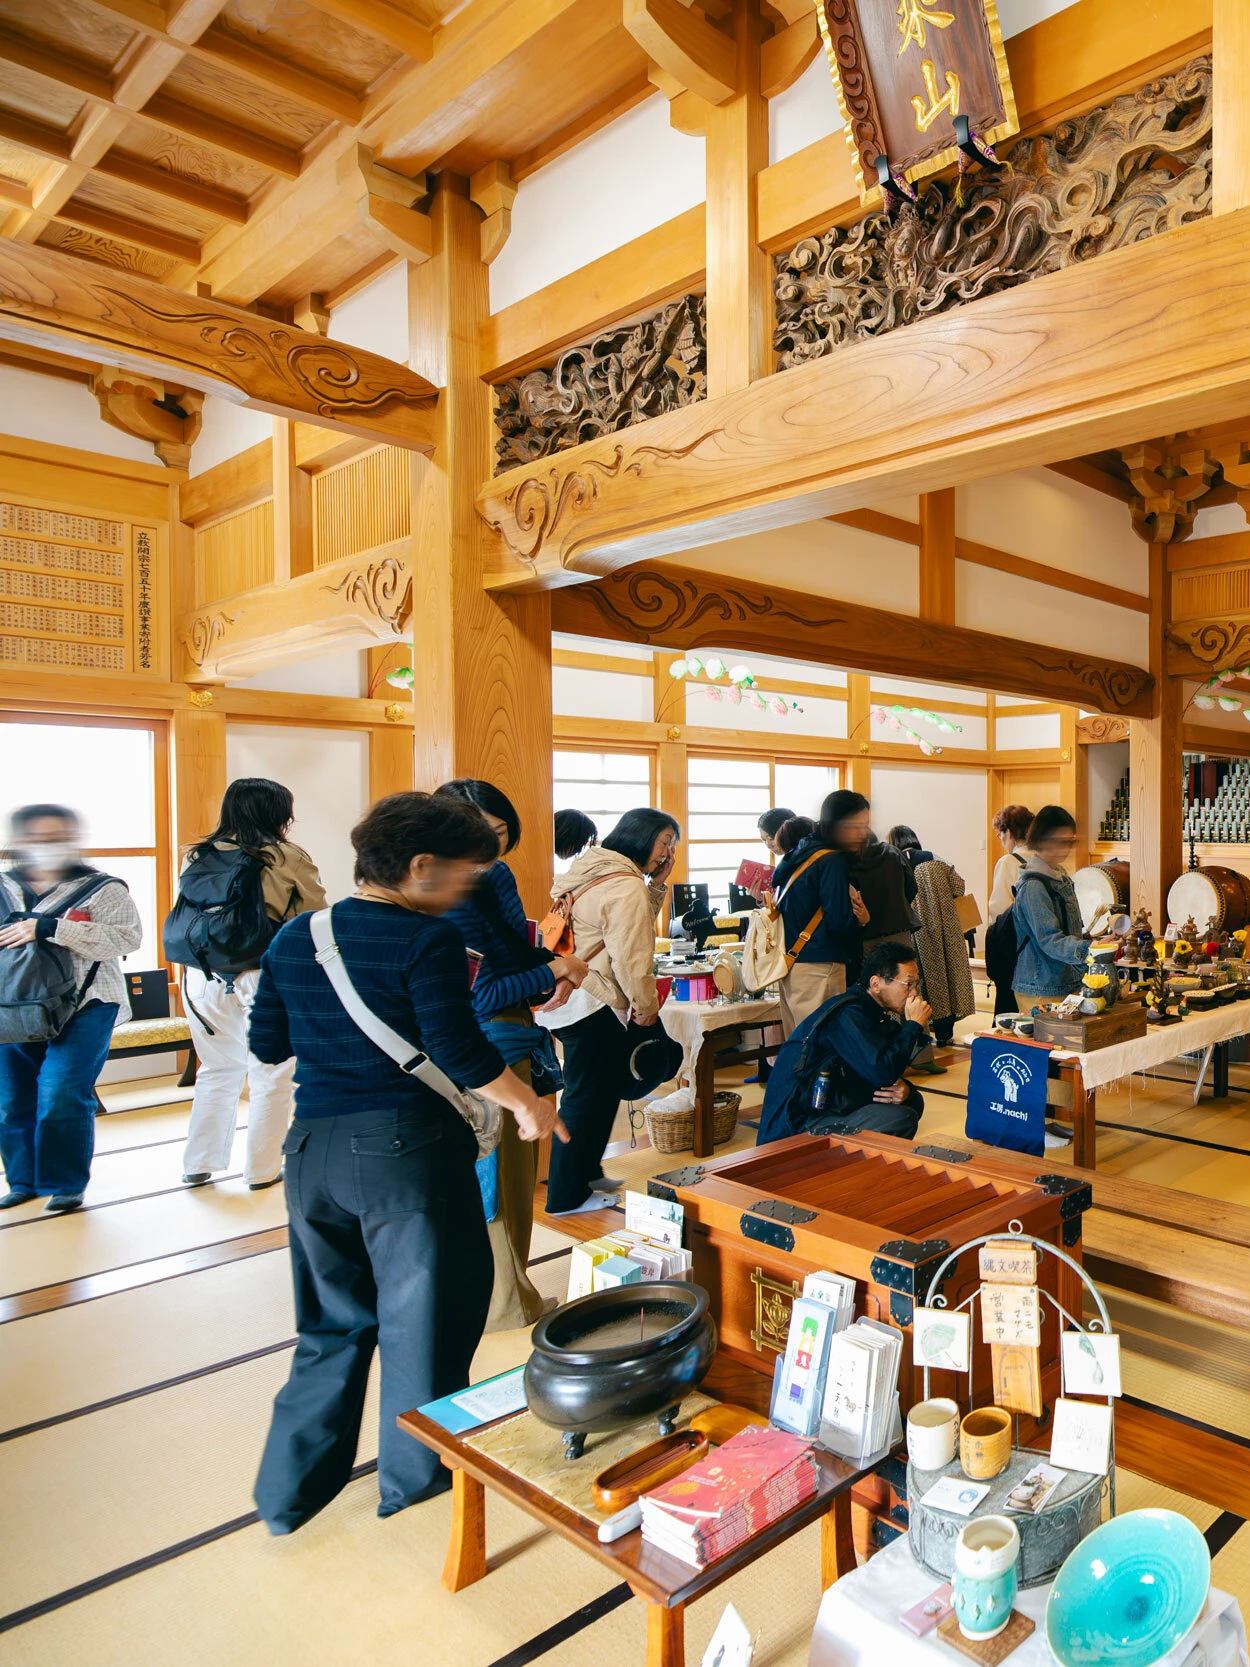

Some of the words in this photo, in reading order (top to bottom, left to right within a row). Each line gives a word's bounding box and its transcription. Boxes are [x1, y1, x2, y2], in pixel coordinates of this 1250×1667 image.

[982, 1257, 1033, 1275] 縄文喫茶
[989, 1291, 1006, 1339] 営業中
